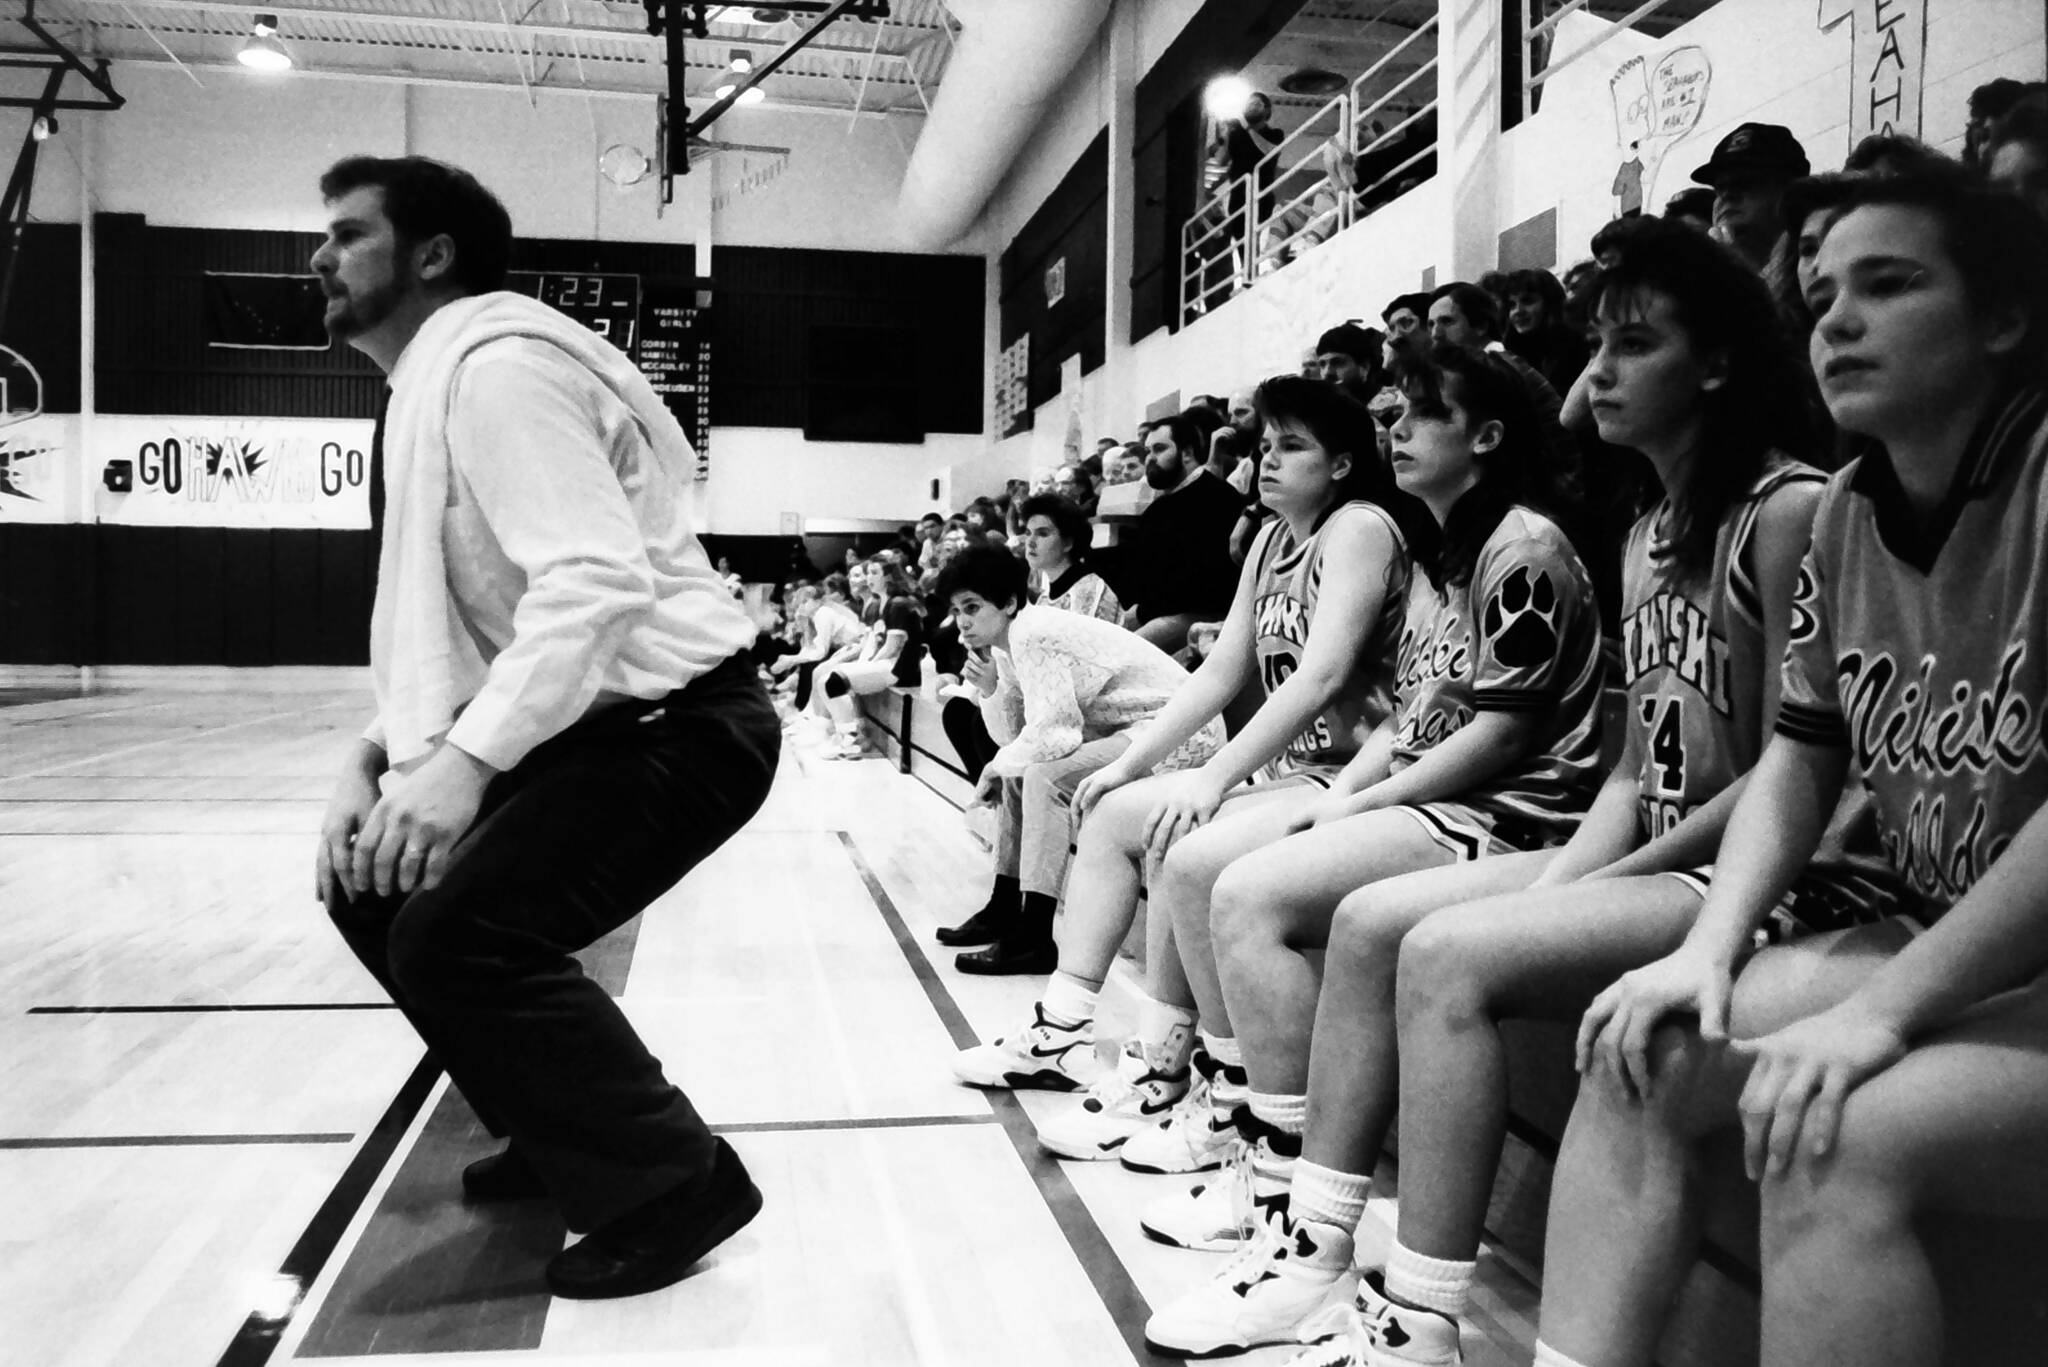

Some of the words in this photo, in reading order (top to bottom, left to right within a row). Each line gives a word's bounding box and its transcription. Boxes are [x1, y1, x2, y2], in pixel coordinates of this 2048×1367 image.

[537, 276, 604, 307] 1:23
[653, 308, 698, 317] VARSITY
[660, 319, 691, 328] GIRLS
[698, 352, 711, 361] 20
[640, 361, 691, 371] MCCAULEY
[698, 363, 709, 372] 21
[697, 395, 709, 405] 24
[139, 437, 182, 494] GO
[1264, 651, 1298, 693] 10
